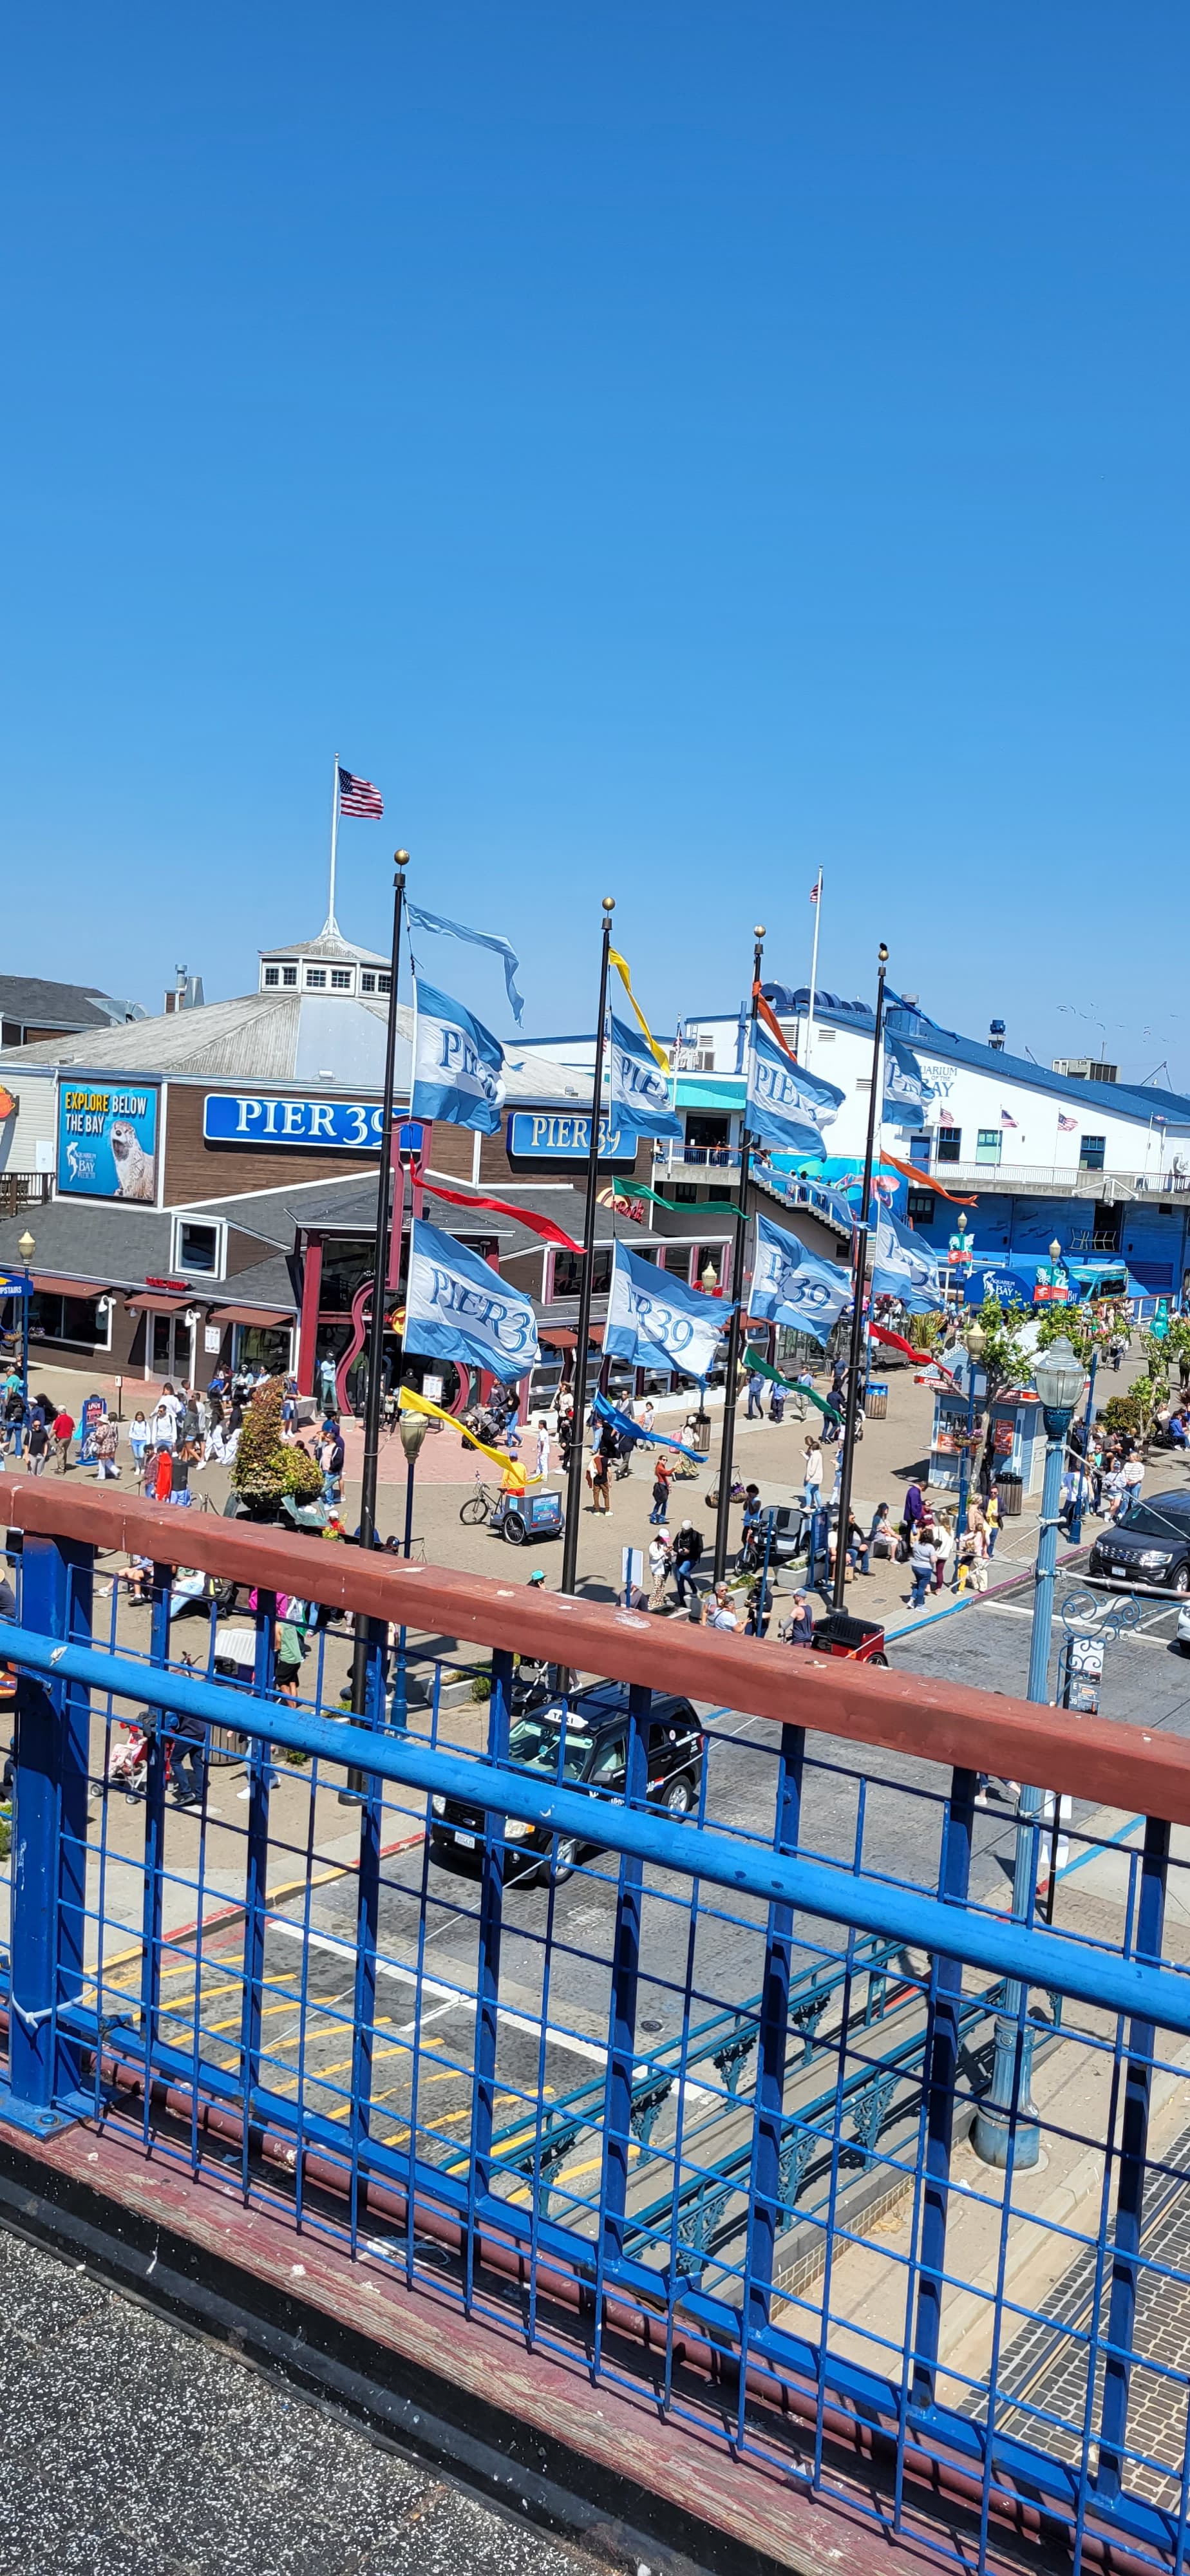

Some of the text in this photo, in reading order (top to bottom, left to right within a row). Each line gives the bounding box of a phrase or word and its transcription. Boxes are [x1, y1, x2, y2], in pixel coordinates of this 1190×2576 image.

[621, 1056, 662, 1098] PIE
[920, 1065, 958, 1076] UARIUM
[66, 1092, 147, 1115] EXPLORE BELOW
[65, 1113, 104, 1133] THE BAY
[236, 1099, 337, 1137] PIER
[531, 1117, 589, 1148] PIER
[79, 1159, 95, 1172] BAY
[996, 1285, 1014, 1296] BAY
[1068, 1290, 1078, 1302] BAY
[430, 1267, 508, 1340] PIER
